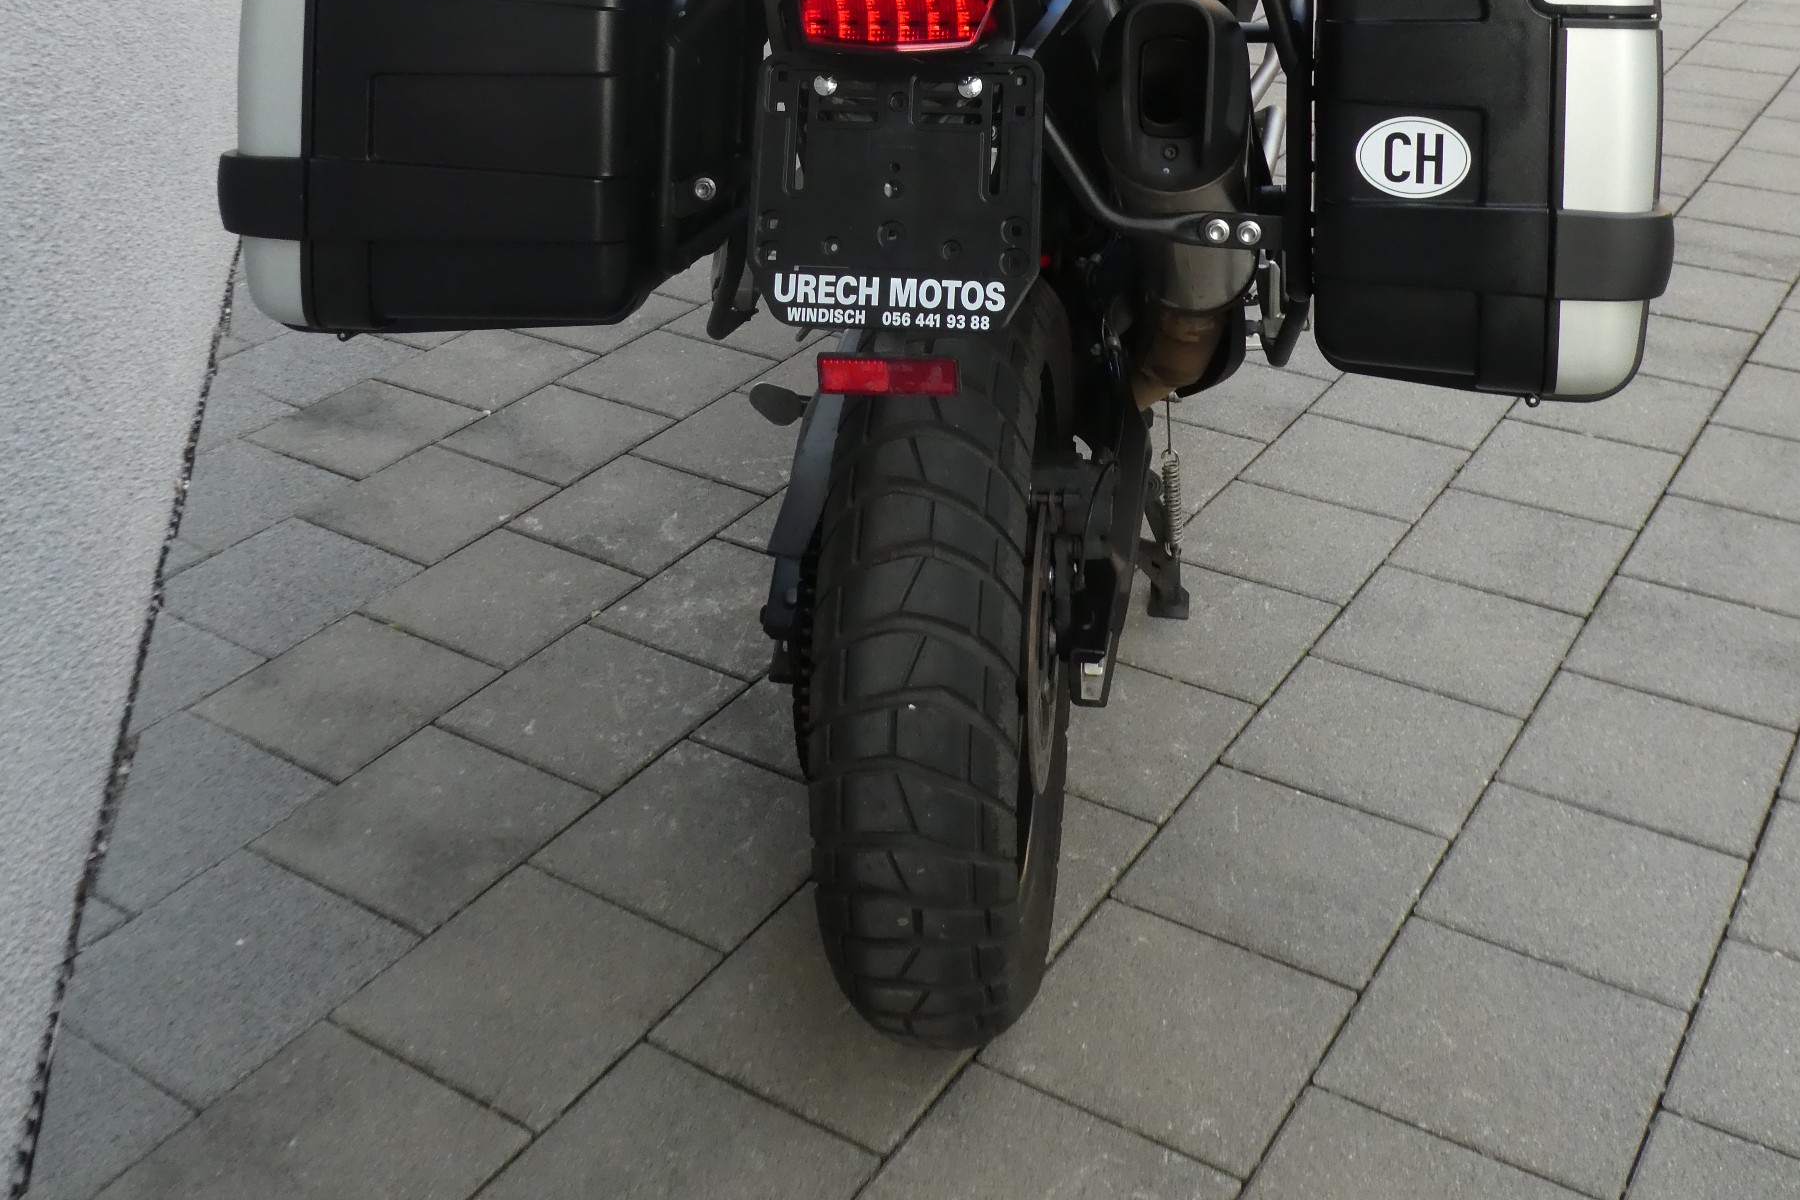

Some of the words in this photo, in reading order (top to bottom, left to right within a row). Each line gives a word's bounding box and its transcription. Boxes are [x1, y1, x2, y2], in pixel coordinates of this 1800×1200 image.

[1384, 132, 1444, 184] CH
[774, 272, 879, 306] URECH
[889, 277, 1006, 311] MOTOS
[787, 307, 866, 324] WINDISCH
[882, 311, 911, 327] 056
[915, 312, 941, 328] 441
[946, 314, 966, 329] 93
[970, 316, 990, 330] 88
